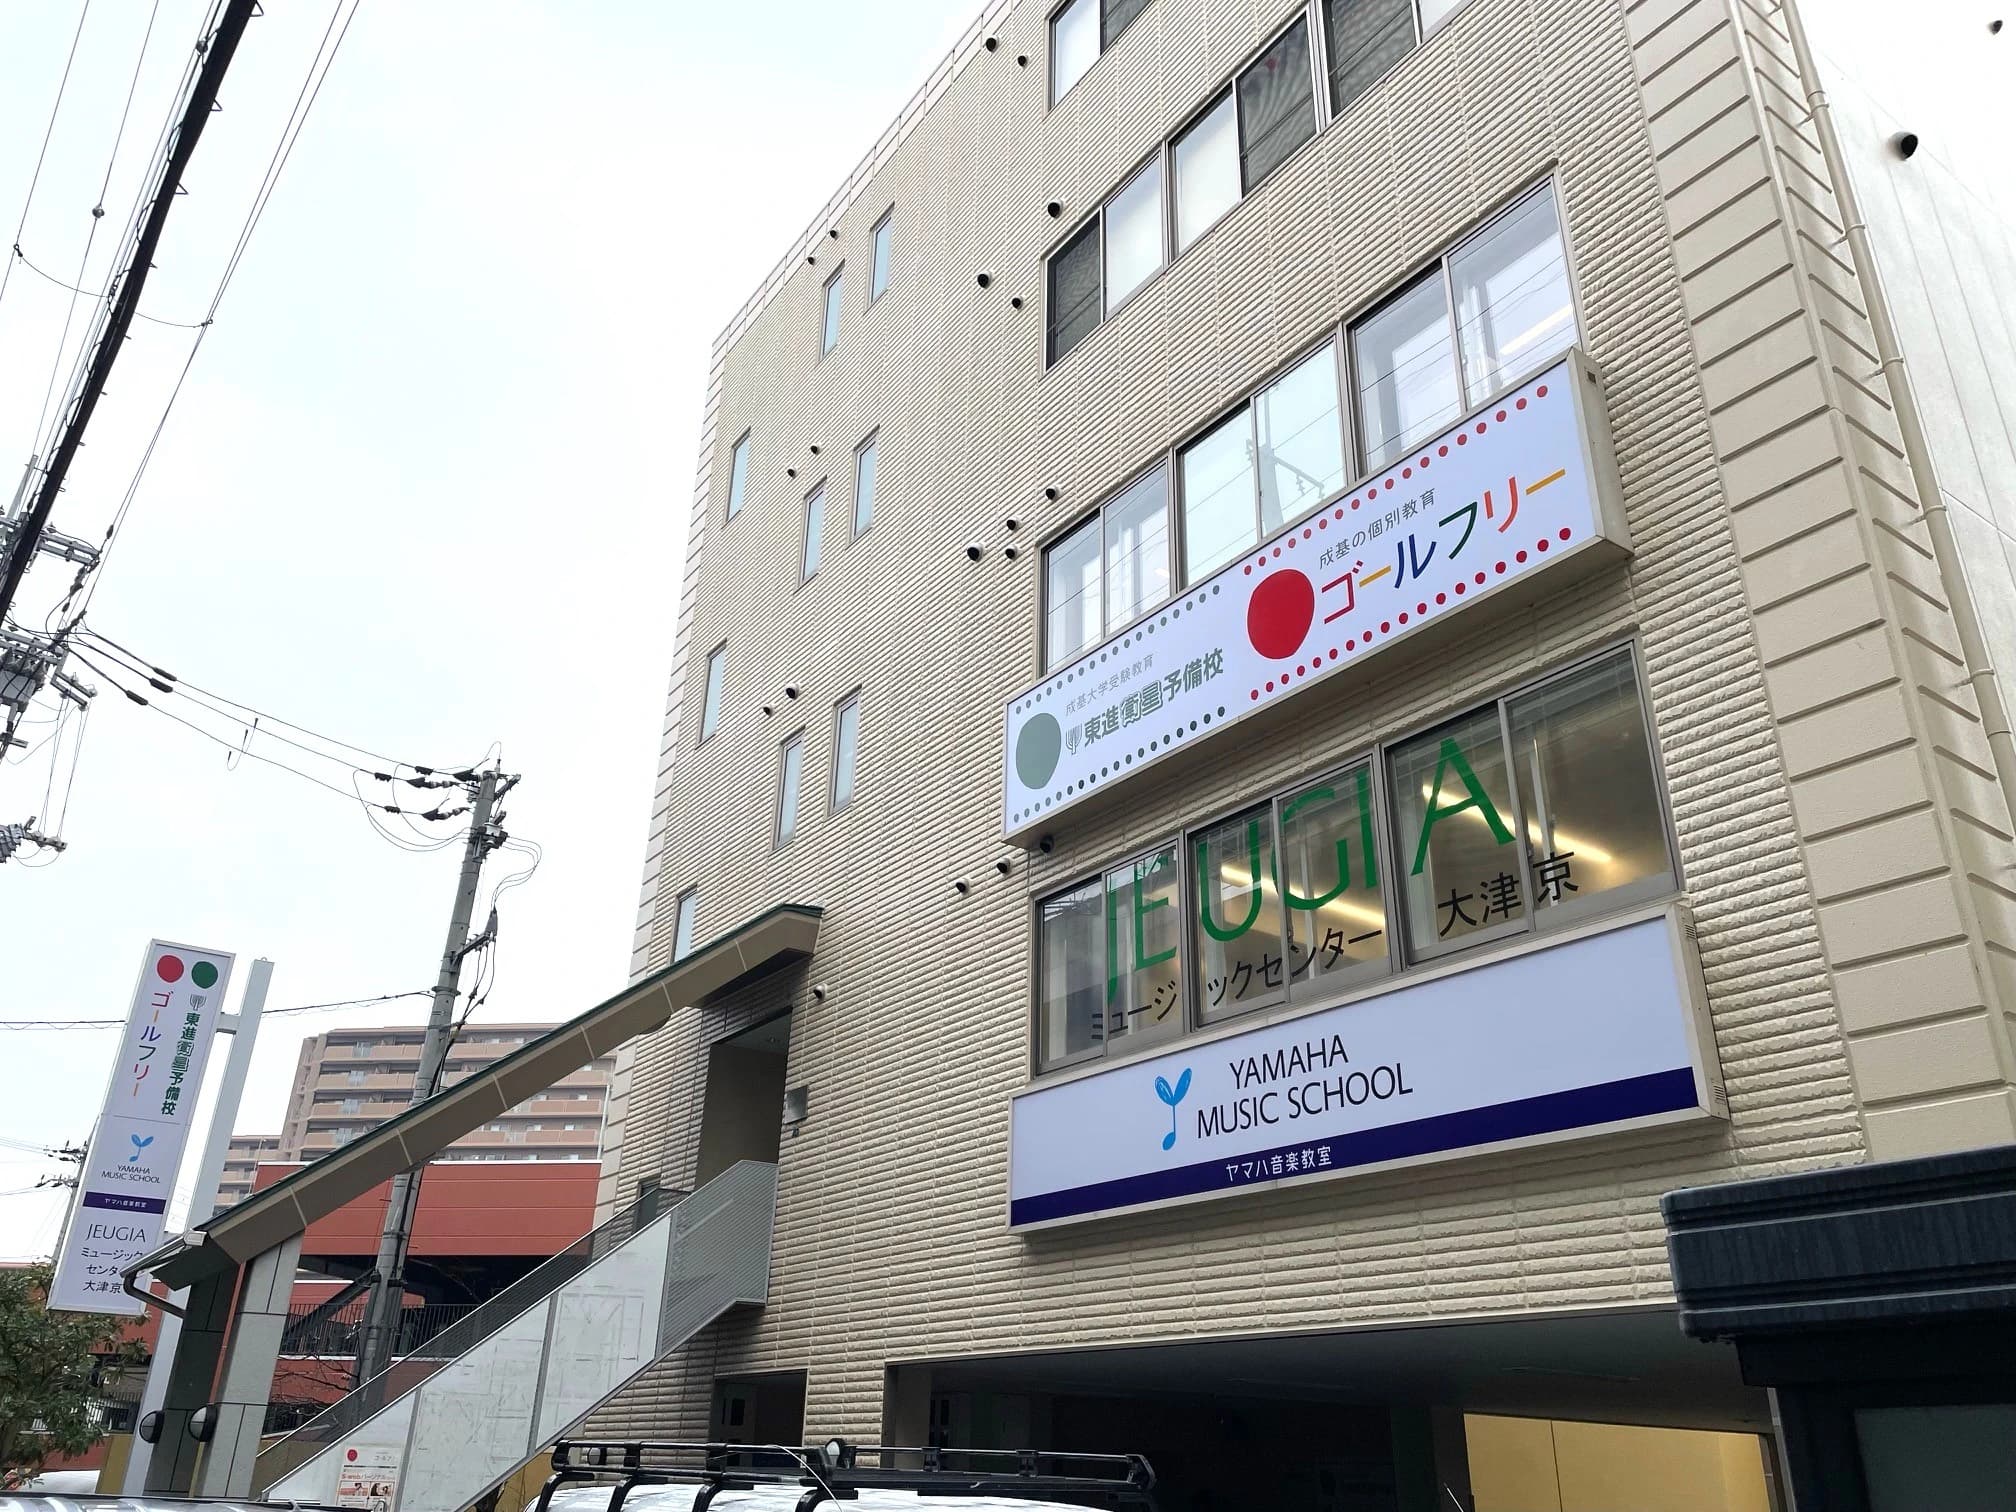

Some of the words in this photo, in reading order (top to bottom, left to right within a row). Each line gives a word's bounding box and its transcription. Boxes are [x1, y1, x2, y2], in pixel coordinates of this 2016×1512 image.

[1318, 487, 1436, 569] 成基の個別教育
[1320, 467, 1566, 625] ゴールフリー
[1084, 647, 1224, 747] 東進衛星予備校
[1437, 851, 1578, 937] 大津京
[134, 990, 174, 1097] ゴールフリー
[161, 1012, 201, 1116] 東進衛星予備校
[1229, 1034, 1349, 1090] YAMAHA
[1197, 1092, 1280, 1139] MUSIC
[1288, 1062, 1413, 1120] SCHOOL
[101, 1170, 127, 1180] MUSIC
[128, 1174, 161, 1184] SCHOOL
[117, 1164, 151, 1174] YAMAHA
[1225, 1146, 1332, 1182] ヤマハ音楽教室
[85, 1223, 146, 1242] JEUGIA
[82, 1280, 122, 1293] 大津京
[86, 1264, 120, 1276] センタ
